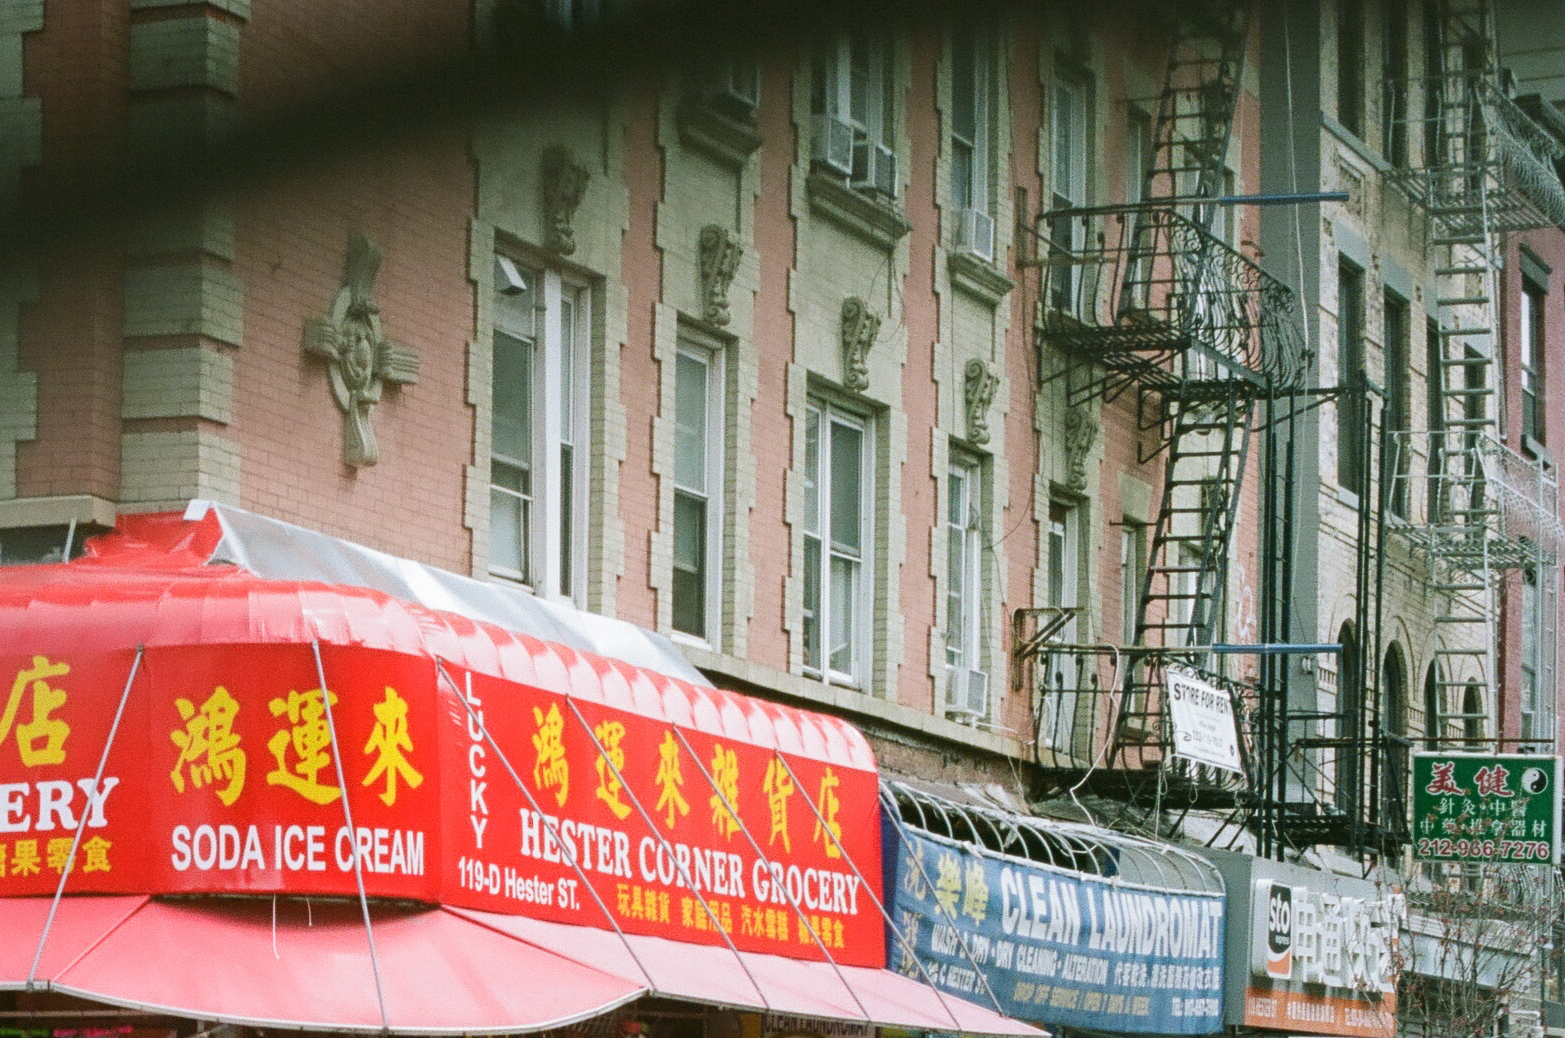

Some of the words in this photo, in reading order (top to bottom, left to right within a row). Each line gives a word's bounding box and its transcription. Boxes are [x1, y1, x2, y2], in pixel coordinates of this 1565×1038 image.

[170, 685, 425, 807] 鴻運來
[465, 671, 488, 849] LUCKY
[531, 702, 842, 859] 鴻運來雜貨店
[1425, 761, 1515, 797] 美健
[171, 824, 265, 871] SODA
[274, 825, 326, 871] ICE
[334, 826, 425, 876] CREAM
[458, 856, 501, 896] 119-D
[504, 867, 554, 906] Hester
[557, 879, 580, 911] ST.
[518, 808, 633, 880] HESTER
[639, 836, 746, 899] CORNER
[751, 858, 861, 915] GROCERY
[1418, 837, 1550, 860] 212-966-7276
[1000, 867, 1082, 946] CLEAN
[1087, 884, 1223, 959] LAUNDROMAT
[1269, 892, 1291, 934] sto
